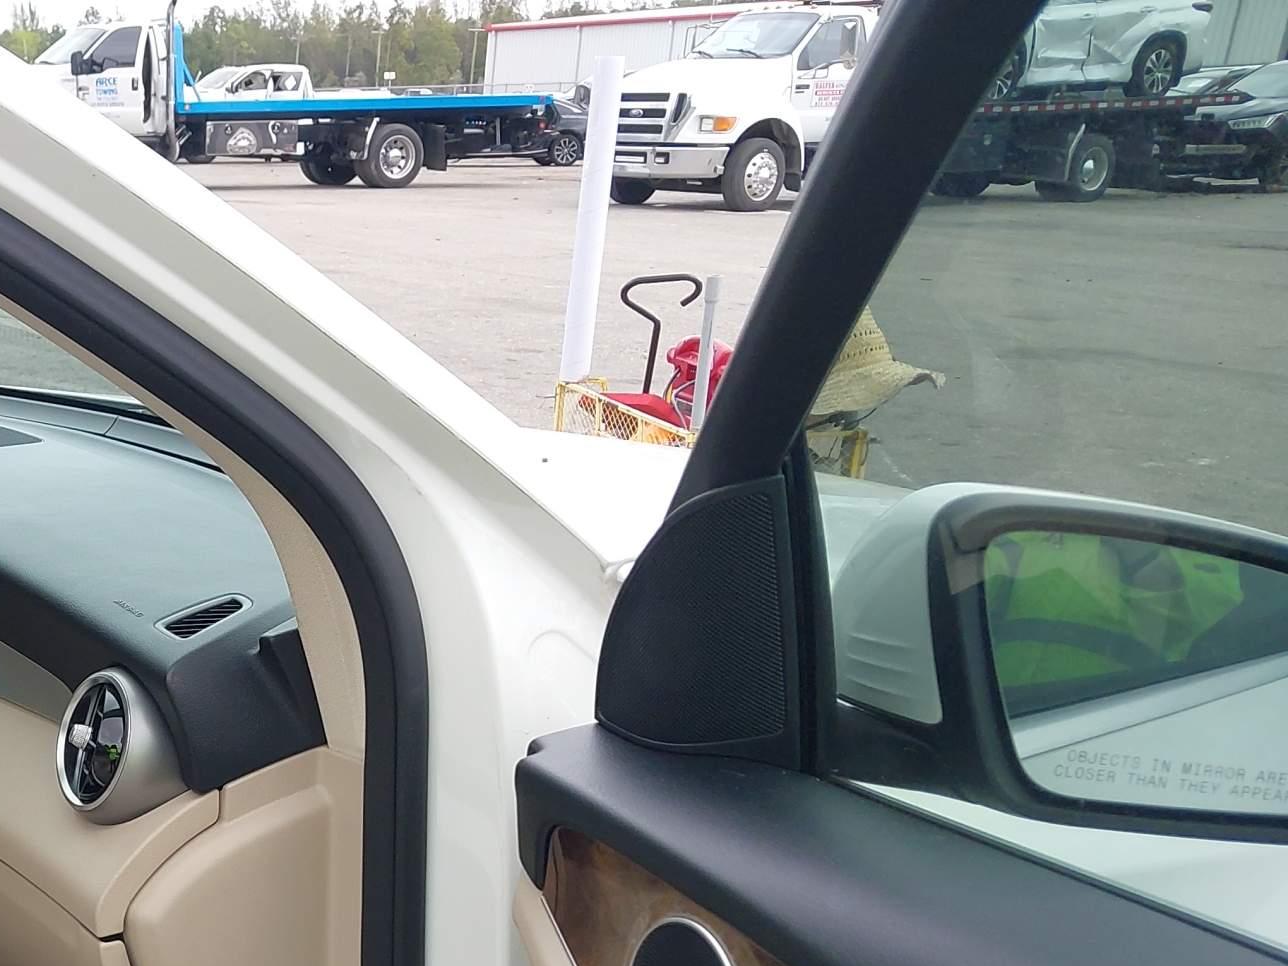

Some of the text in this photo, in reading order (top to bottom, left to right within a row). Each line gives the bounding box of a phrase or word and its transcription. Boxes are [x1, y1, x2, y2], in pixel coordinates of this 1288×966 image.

[95, 77, 118, 87] ARCE
[1053, 763, 1117, 784] CLOSER
[1127, 772, 1169, 790] THAN
[1179, 778, 1221, 796] THEY
[1066, 748, 1288, 787] OBJECTS IN MIRROR ARE
